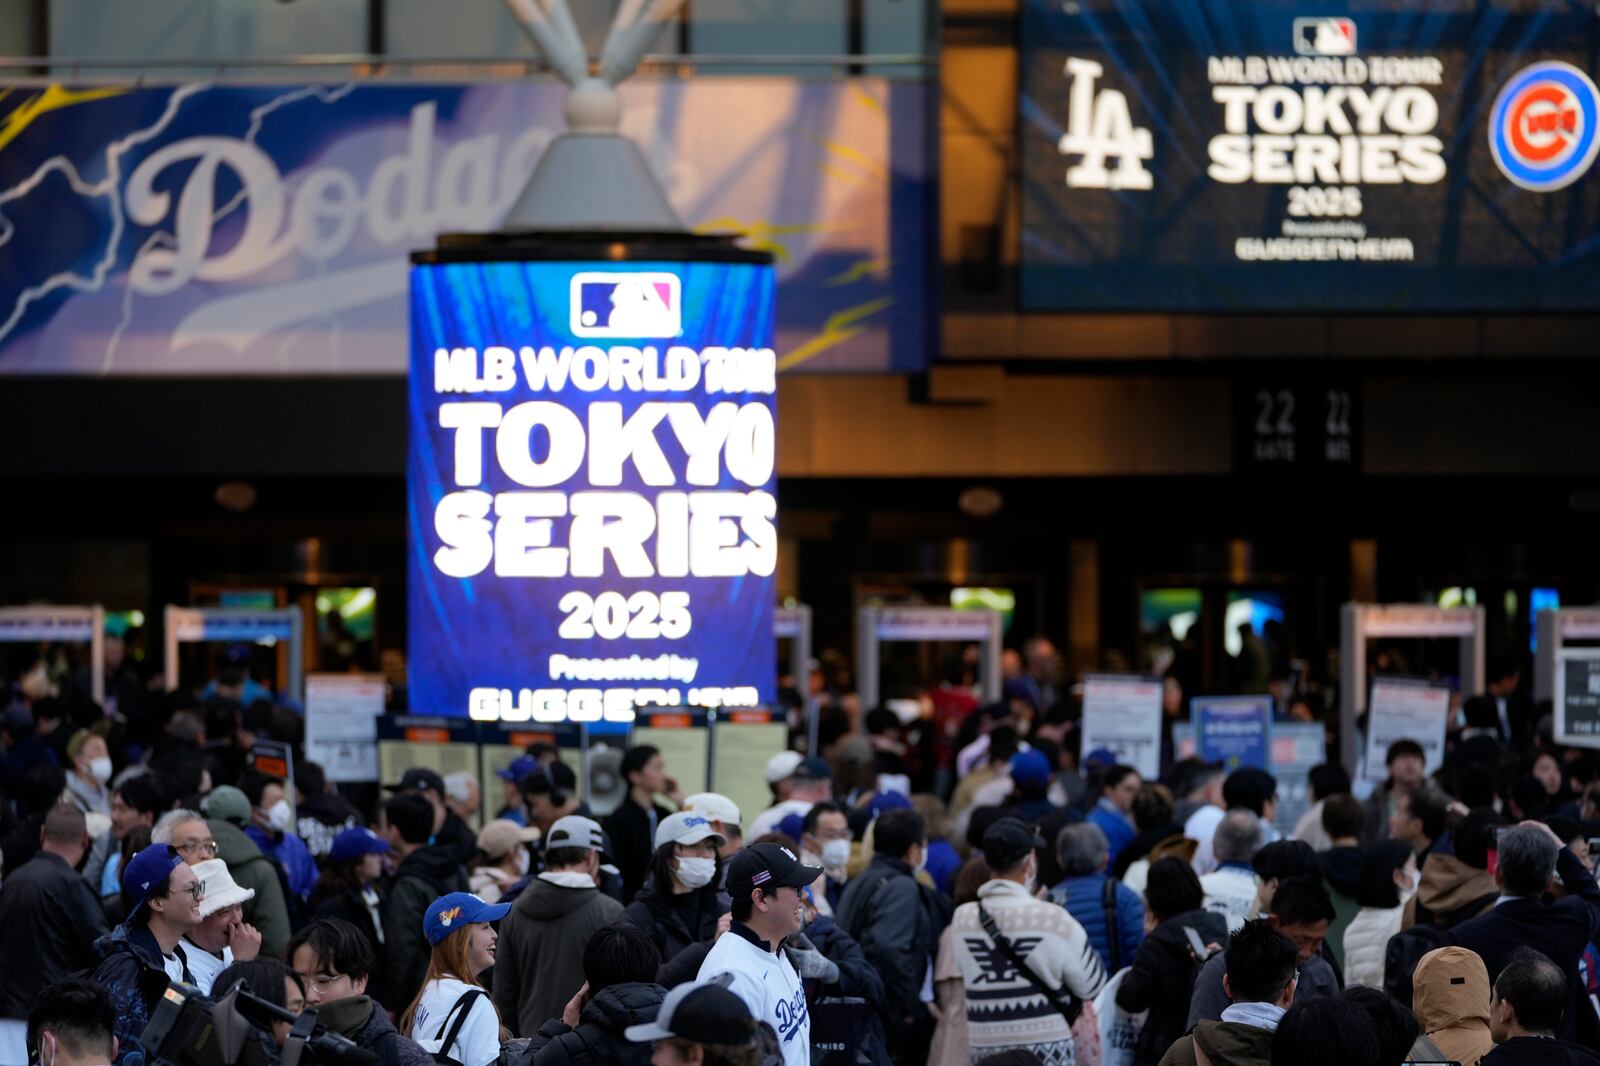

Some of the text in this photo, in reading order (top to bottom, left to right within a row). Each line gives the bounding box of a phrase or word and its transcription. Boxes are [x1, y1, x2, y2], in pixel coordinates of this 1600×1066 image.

[1208, 57, 1267, 84] MLB
[1268, 57, 1368, 84] WORLD
[1212, 86, 1439, 135] TOKYO
[1207, 135, 1447, 184] SERIES
[127, 100, 558, 296] Dodg
[1287, 186, 1363, 217] 2025
[1235, 237, 1414, 260] GUGGENHEIM
[434, 347, 517, 393] MLB
[519, 346, 701, 392] WORLD
[1255, 389, 1296, 434] 22
[438, 401, 775, 487] TOKYO
[433, 490, 777, 578] SERIES
[558, 591, 691, 639] 2025
[549, 654, 699, 683] Presented by
